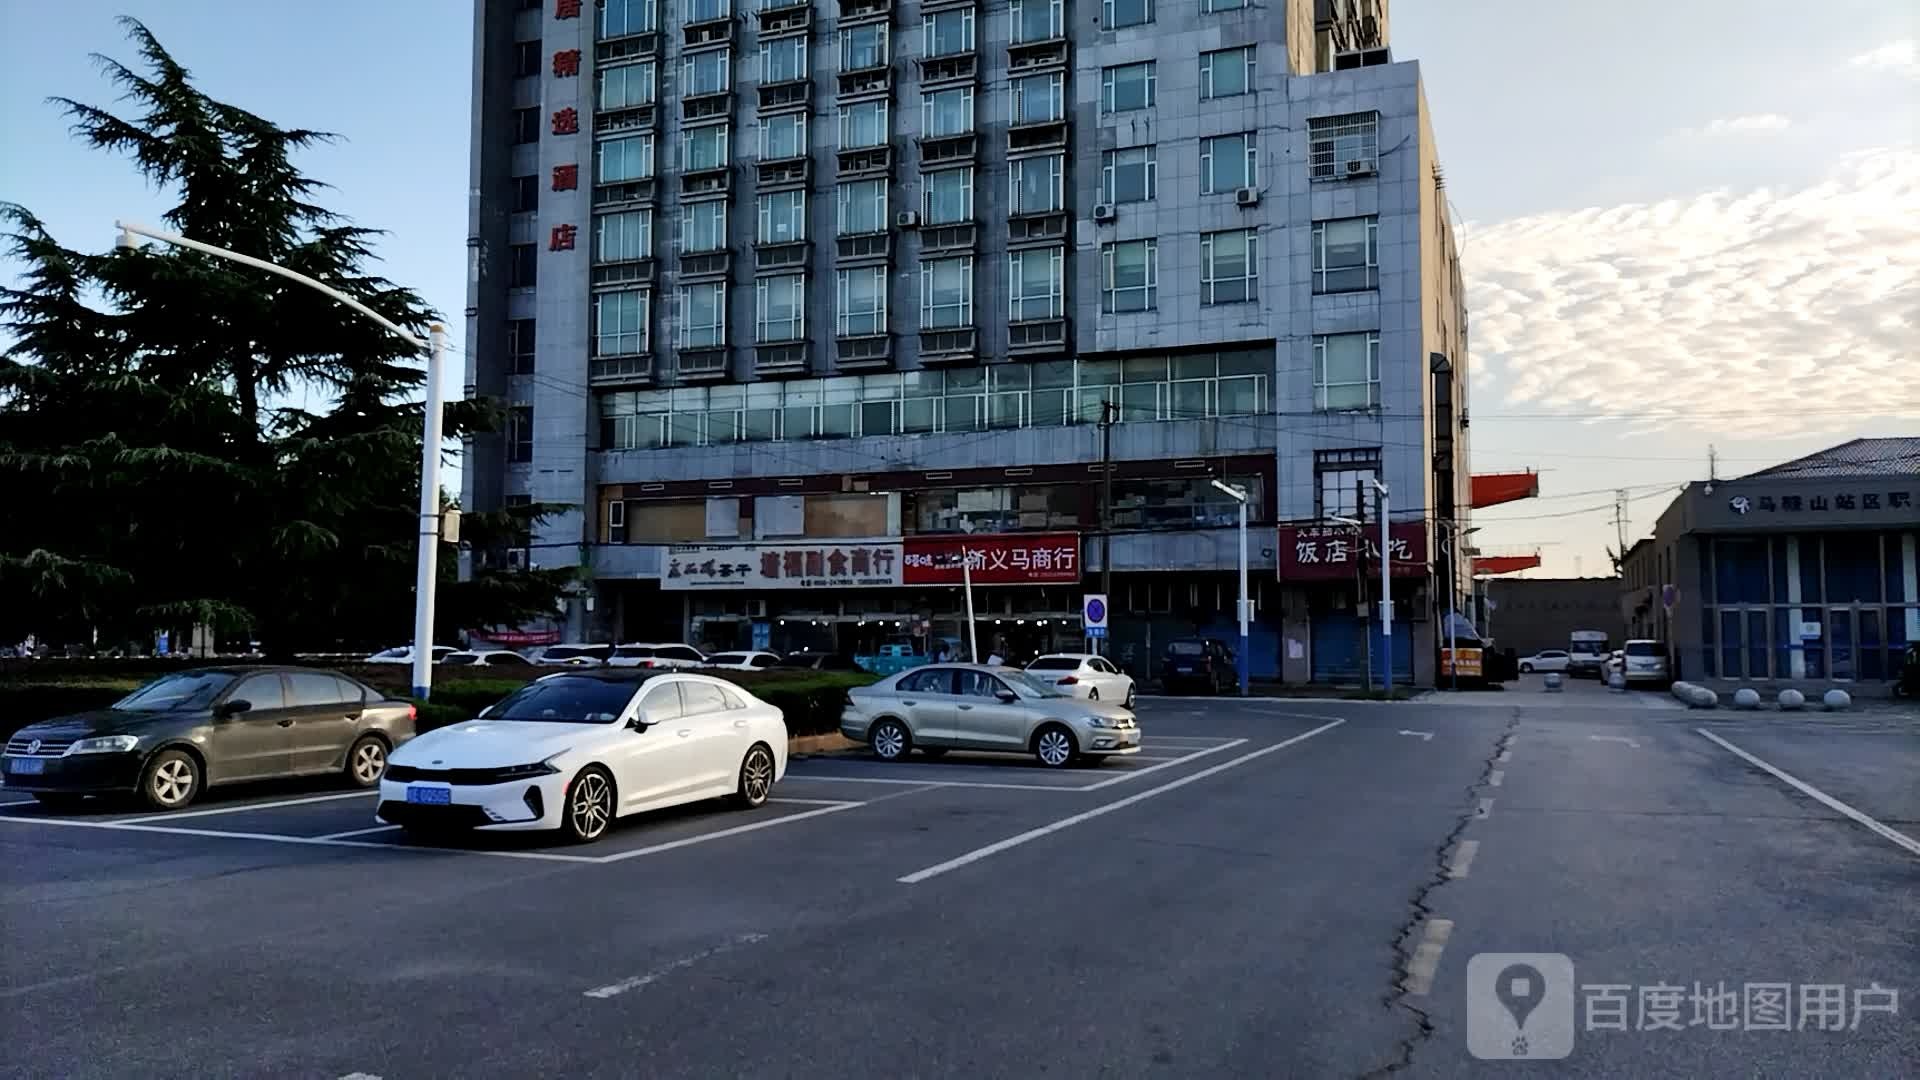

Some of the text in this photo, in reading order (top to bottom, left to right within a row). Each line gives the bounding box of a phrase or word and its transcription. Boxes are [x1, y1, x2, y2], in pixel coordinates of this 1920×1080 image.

[1758, 491, 1920, 512] 马鞍山站区职
[967, 546, 1076, 571] 新义马商行
